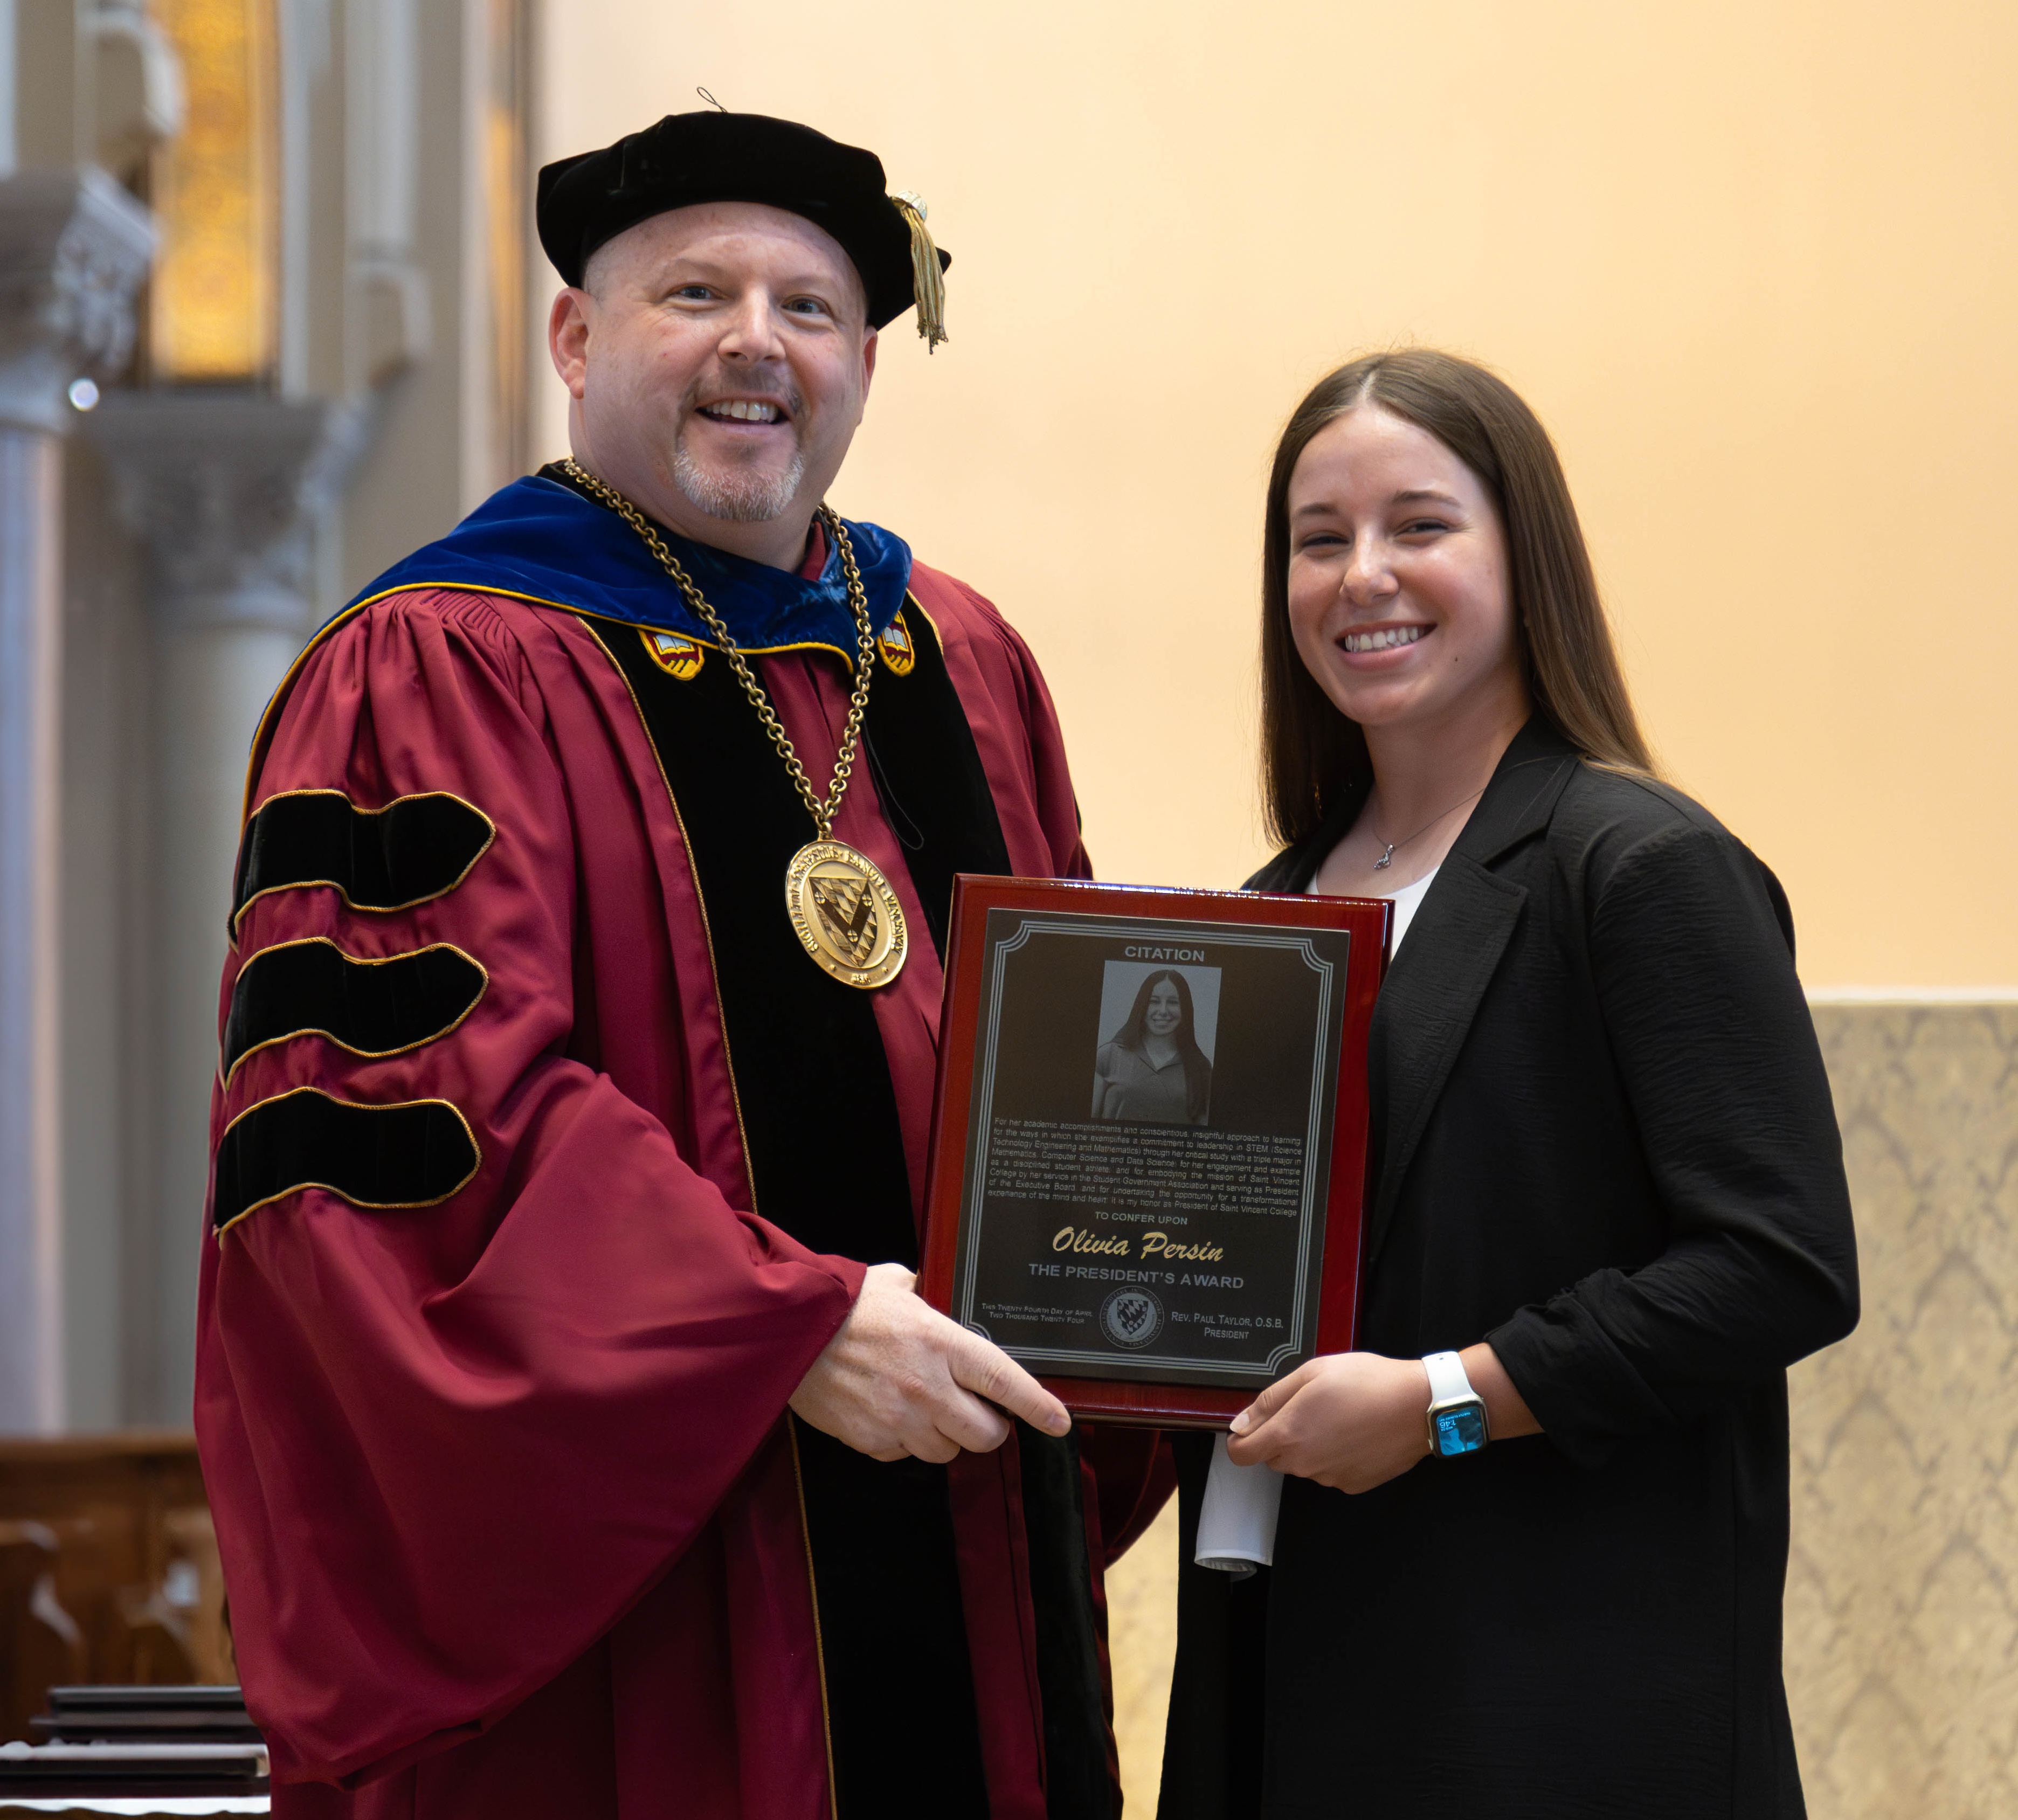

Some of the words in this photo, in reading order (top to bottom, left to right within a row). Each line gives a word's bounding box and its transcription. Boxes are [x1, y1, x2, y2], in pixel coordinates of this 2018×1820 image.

[1125, 946, 1205, 962] CITATION
[1019, 1131, 1038, 1139] ways
[1051, 1131, 1071, 1139] which
[1090, 1134, 1130, 1145] exemplifies
[1141, 1137, 1184, 1147] commitment
[1197, 1141, 1233, 1152] leadership
[1246, 1144, 1268, 1152] STEM
[1023, 1119, 1057, 1129] academic
[1060, 1122, 1121, 1134] accomplishments
[1192, 1131, 1224, 1141] insightful
[1227, 1133, 1260, 1144] approach
[992, 1138, 1032, 1149] Technology
[1034, 1141, 1076, 1152] Engineering
[1093, 1145, 1141, 1156] Mathematics)
[1143, 1147, 1170, 1158] through
[1185, 1150, 1208, 1159] critical
[1210, 1152, 1228, 1161] study
[1253, 1154, 1270, 1165] triple
[1273, 1156, 1292, 1166] major
[1041, 1151, 1076, 1162] Computer
[1079, 1154, 1107, 1162] Science
[1110, 1155, 1124, 1164] and
[1127, 1157, 1143, 1165] Data
[1206, 1162, 1250, 1173] engagement
[1254, 1165, 1267, 1173] and
[1270, 1166, 1300, 1177] example
[989, 1168, 1017, 1179] College
[1018, 1170, 1027, 1179] by
[1043, 1172, 1069, 1180] service
[1093, 1175, 1120, 1184] Student
[1122, 1177, 1166, 1187] Government
[1168, 1180, 1208, 1189] Association
[1211, 1182, 1224, 1191] and
[1226, 1184, 1252, 1194] serving
[1265, 1186, 1298, 1195] President
[1013, 1160, 1050, 1171] disciplined
[1054, 1162, 1081, 1171] student
[1116, 1166, 1129, 1174] and
[1148, 1168, 1186, 1180] embodying
[1207, 1172, 1234, 1181] mission
[1250, 1175, 1268, 1183] Saint
[1273, 1177, 1299, 1185] Vincent
[987, 1189, 1026, 1200] experience
[1052, 1193, 1069, 1201] mind
[1127, 1199, 1137, 1207] my
[1140, 1199, 1160, 1207] honor
[1174, 1201, 1208, 1209] President
[1220, 1203, 1238, 1212] Saint
[1241, 1205, 1267, 1213] Vincent
[1269, 1207, 1297, 1217] College
[1015, 1180, 1050, 1189] Executive
[1112, 1187, 1155, 1198] undertaking
[1174, 1191, 1213, 1202] opportunity
[1240, 1195, 1297, 1205] transformational
[1095, 1212, 1109, 1220] TO
[1111, 1213, 1155, 1223] CONFER
[1158, 1216, 1188, 1225] UPON
[1052, 1226, 1131, 1256] Olivia
[1141, 1231, 1224, 1262] Persin
[1028, 1263, 1060, 1277] THE
[1065, 1265, 1175, 1285] PRESIDENT'S
[1180, 1273, 1244, 1289] AWARD
[1440, 1420, 1456, 1429] 1:46
